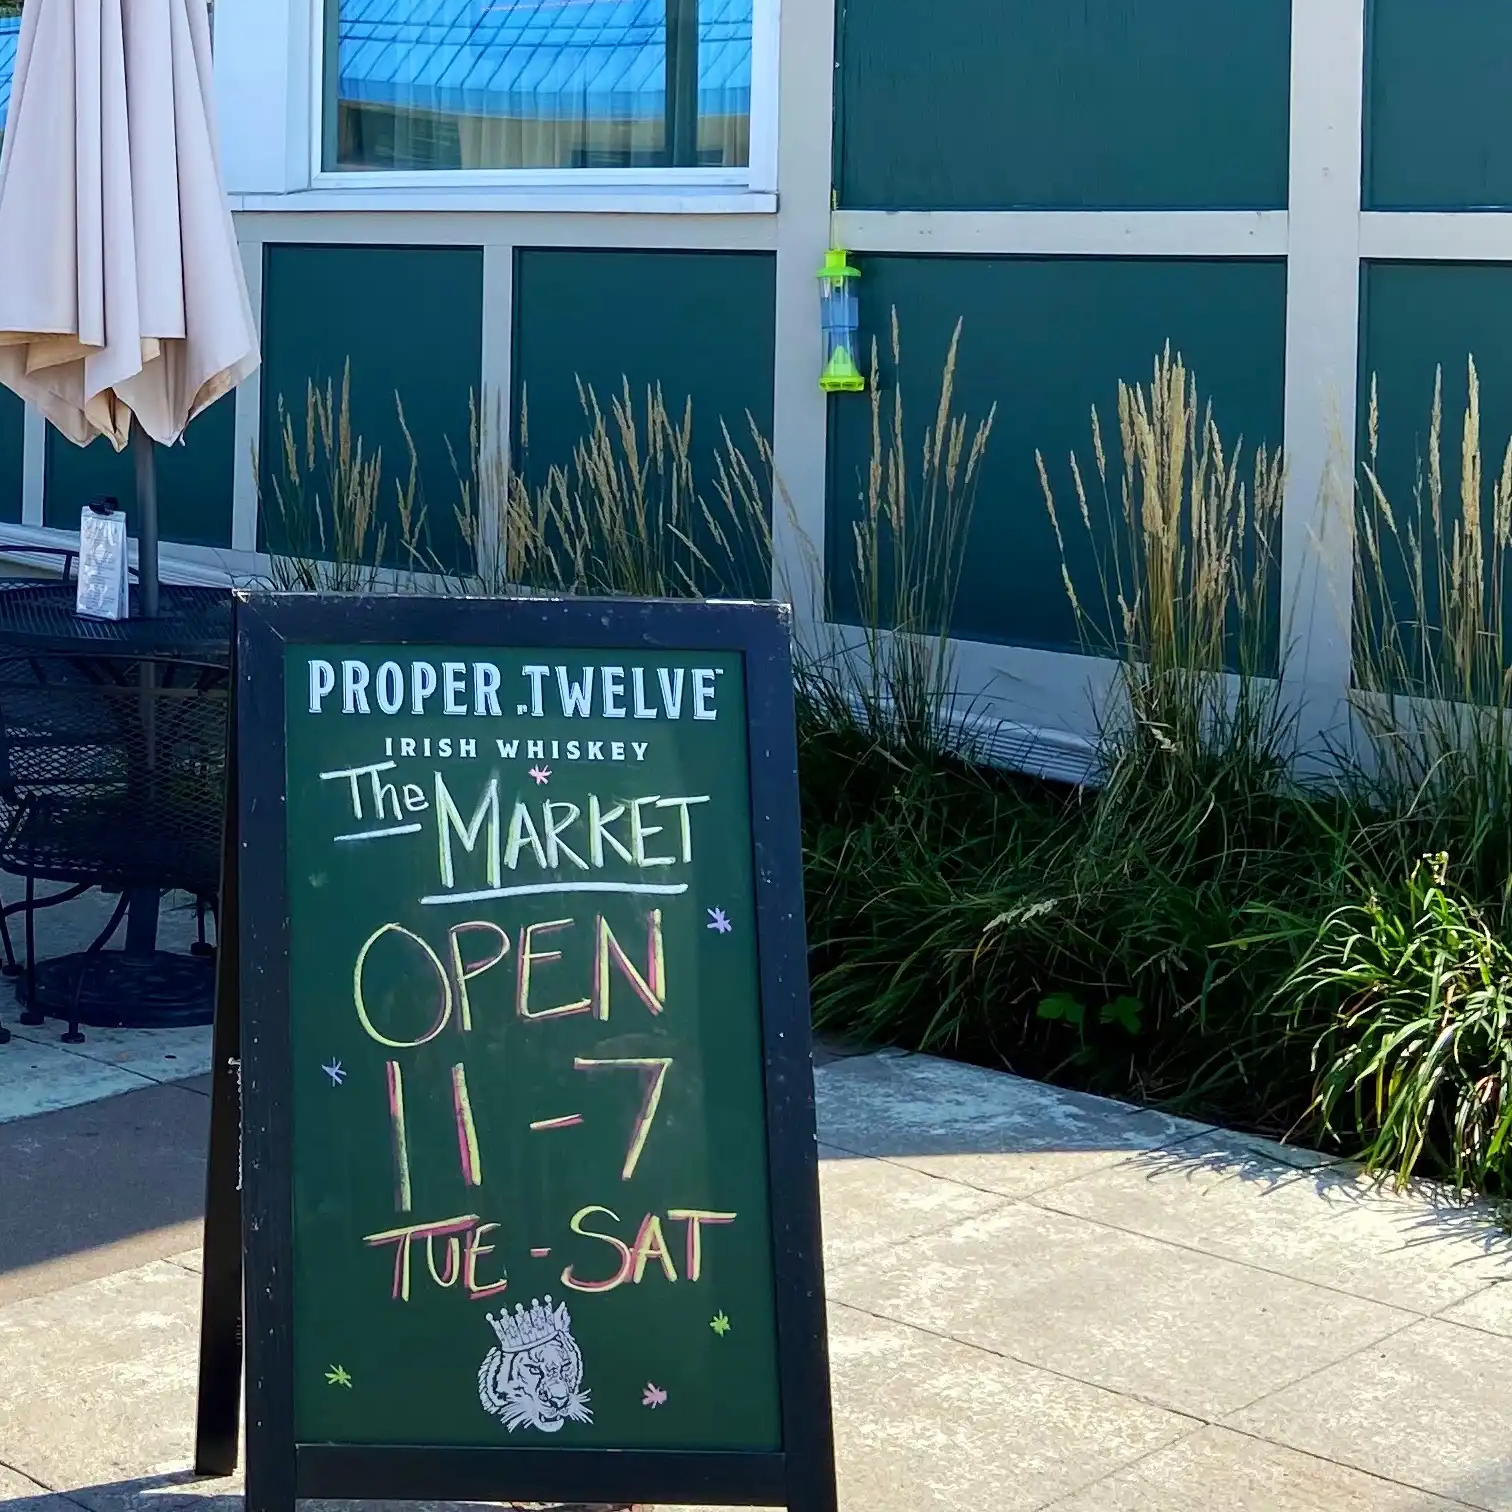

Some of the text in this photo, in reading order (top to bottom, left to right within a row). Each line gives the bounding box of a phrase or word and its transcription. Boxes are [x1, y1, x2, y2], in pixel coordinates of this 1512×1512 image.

[307, 659, 718, 721] PROPER TWELVE
[384, 737, 649, 761] IRISH WHISKEY
[319, 760, 710, 888] The MARKET
[353, 908, 666, 1047] OPEN
